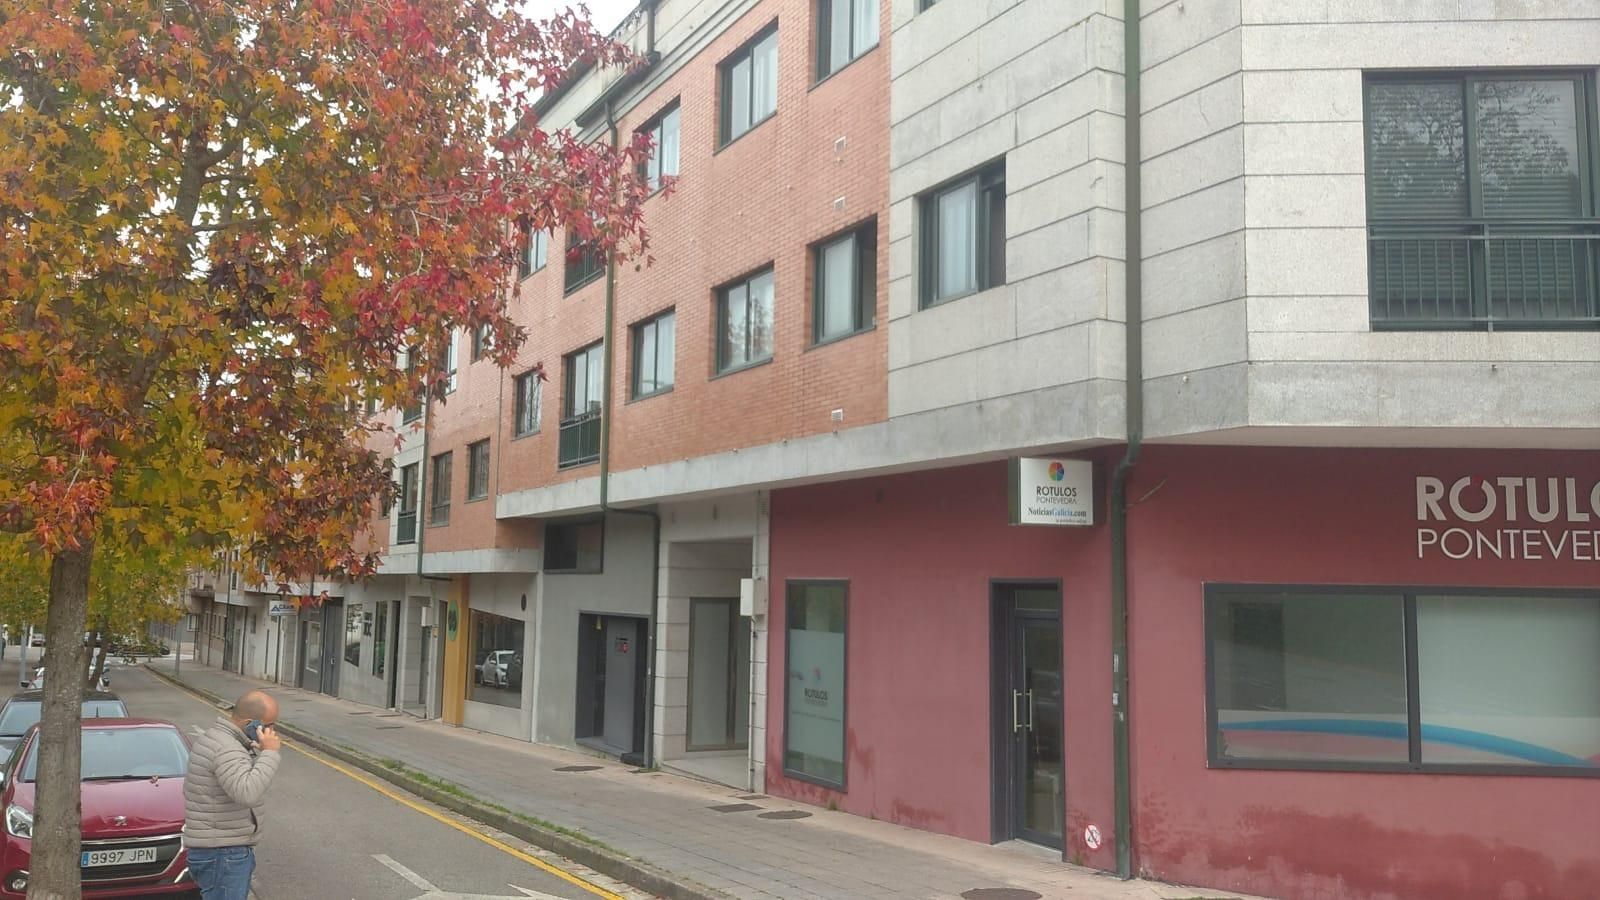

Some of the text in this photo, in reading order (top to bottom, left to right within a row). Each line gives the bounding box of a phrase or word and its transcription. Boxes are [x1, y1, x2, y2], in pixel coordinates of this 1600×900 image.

[1036, 486, 1077, 497] ROTULOS
[1416, 476, 1600, 522] ROTUL
[1417, 528, 1600, 560] PONTEVE
[91, 849, 153, 864] 9997 JPN
